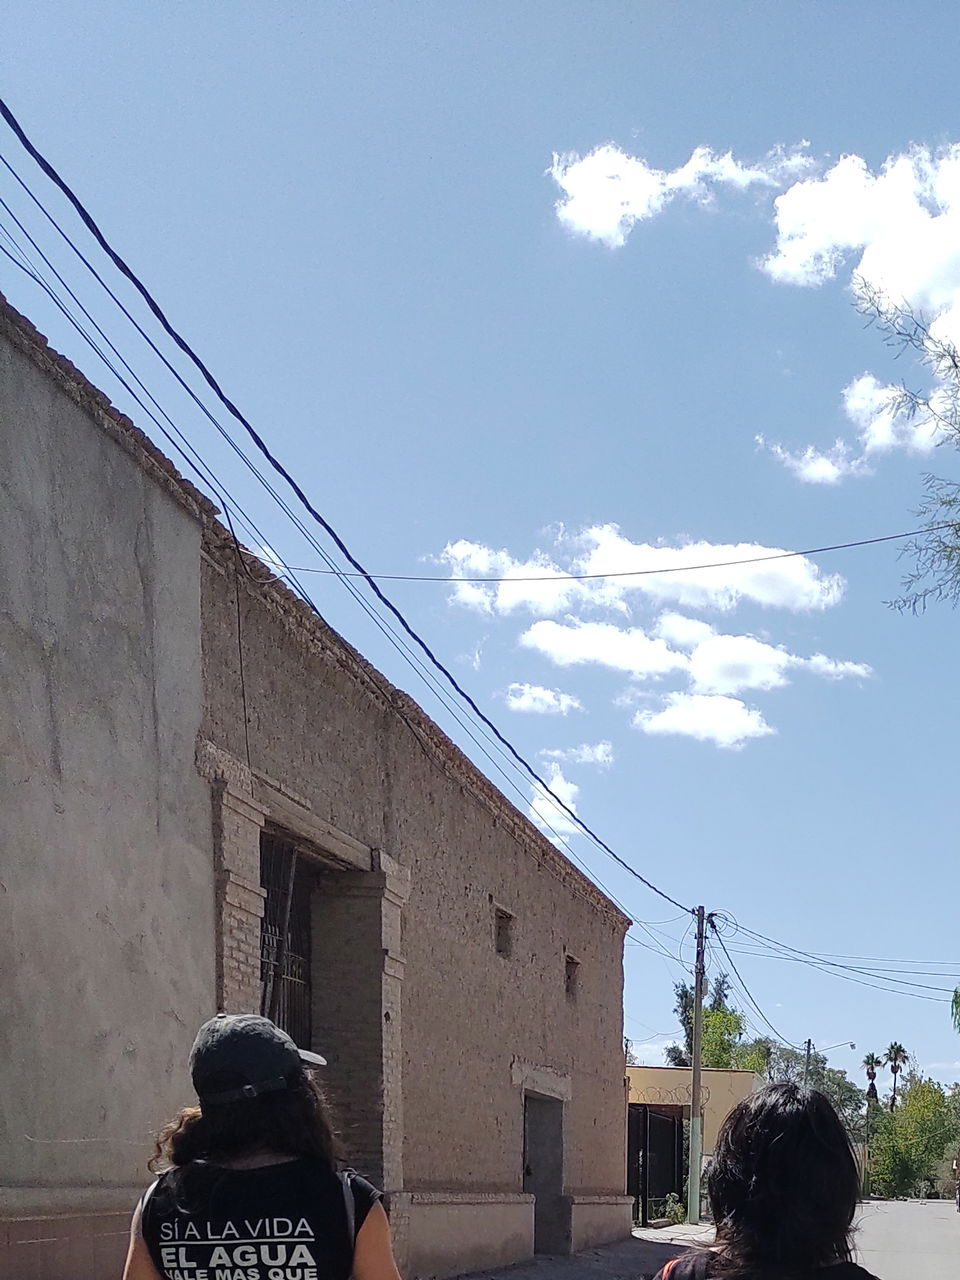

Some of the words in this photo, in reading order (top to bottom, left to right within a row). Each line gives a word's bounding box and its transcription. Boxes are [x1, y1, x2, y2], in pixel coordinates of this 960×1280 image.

[160, 1218, 179, 1240] SÍ
[185, 1221, 200, 1239] A
[207, 1221, 239, 1239] LA
[245, 1217, 314, 1237] VIDA
[161, 1247, 197, 1268] EL
[209, 1244, 316, 1268] AGUA
